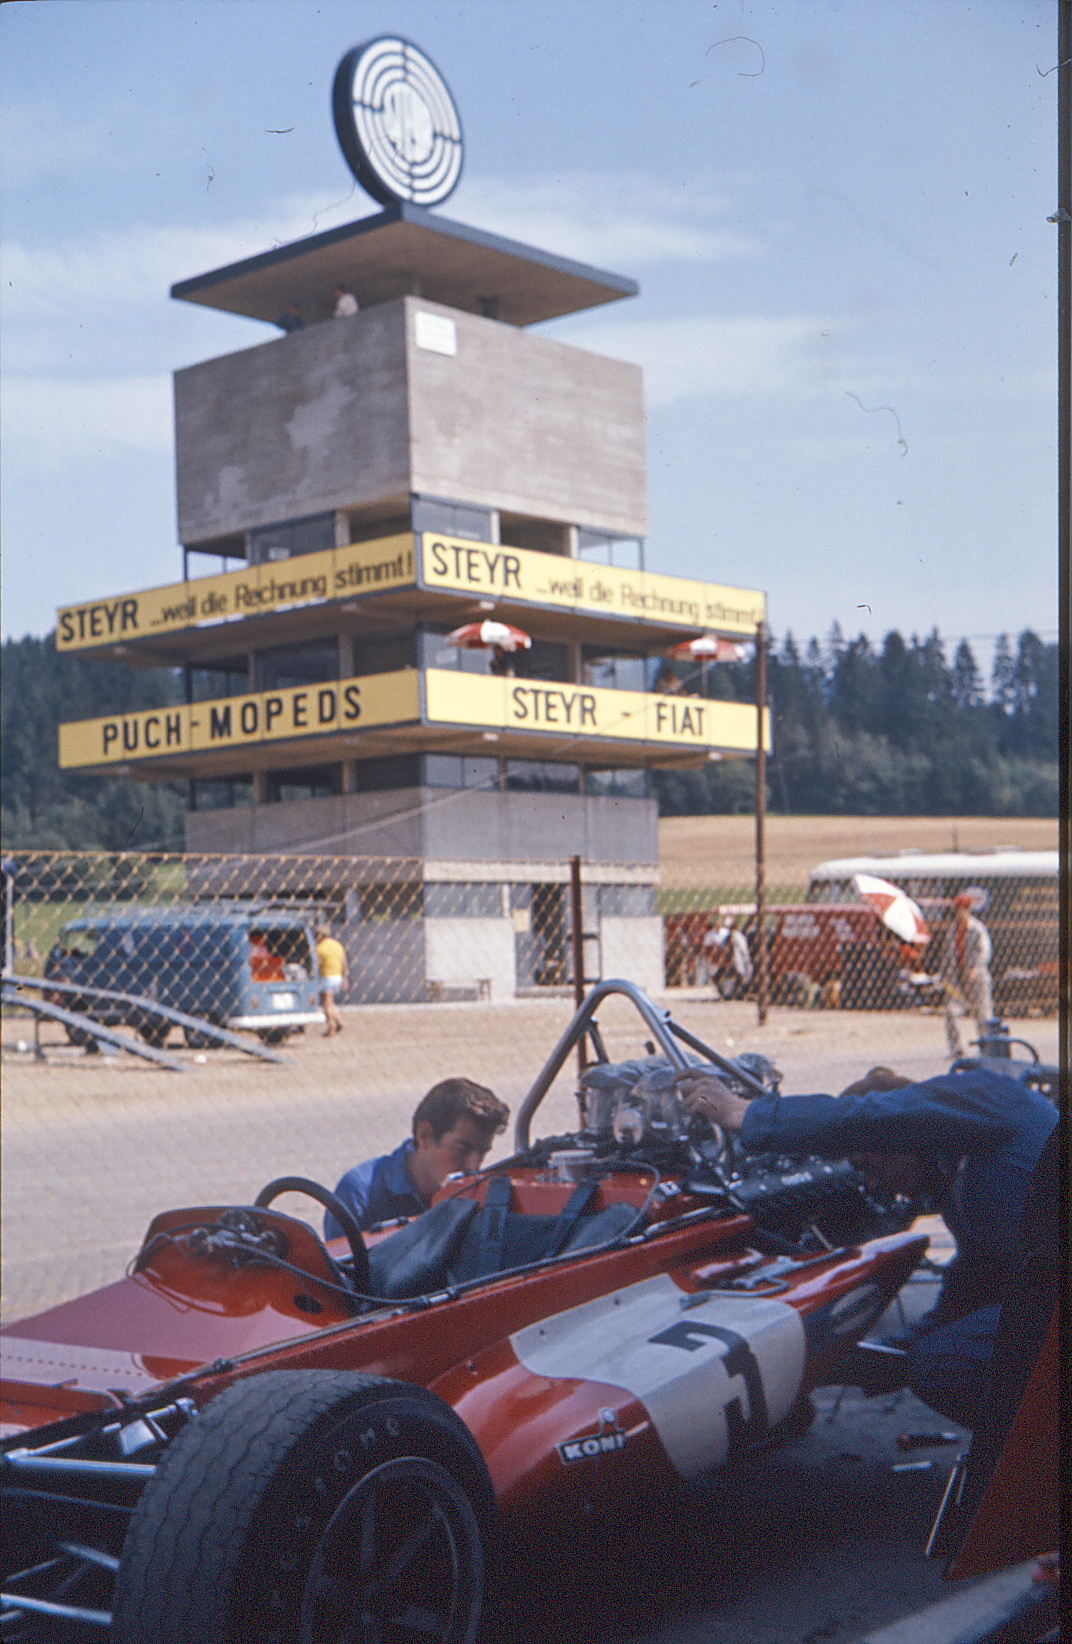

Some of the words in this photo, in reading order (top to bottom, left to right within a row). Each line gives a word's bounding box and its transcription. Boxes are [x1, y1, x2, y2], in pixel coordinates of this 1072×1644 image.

[60, 598, 139, 643] STEYR
[201, 591, 228, 616] die
[235, 573, 327, 609] Rechnung
[432, 542, 521, 589] STEYR
[589, 580, 614, 604] die
[621, 583, 699, 622] Rechnung
[512, 687, 598, 726] STEYR
[656, 702, 705, 737] FIAT
[564, 1434, 625, 1460] KONI
